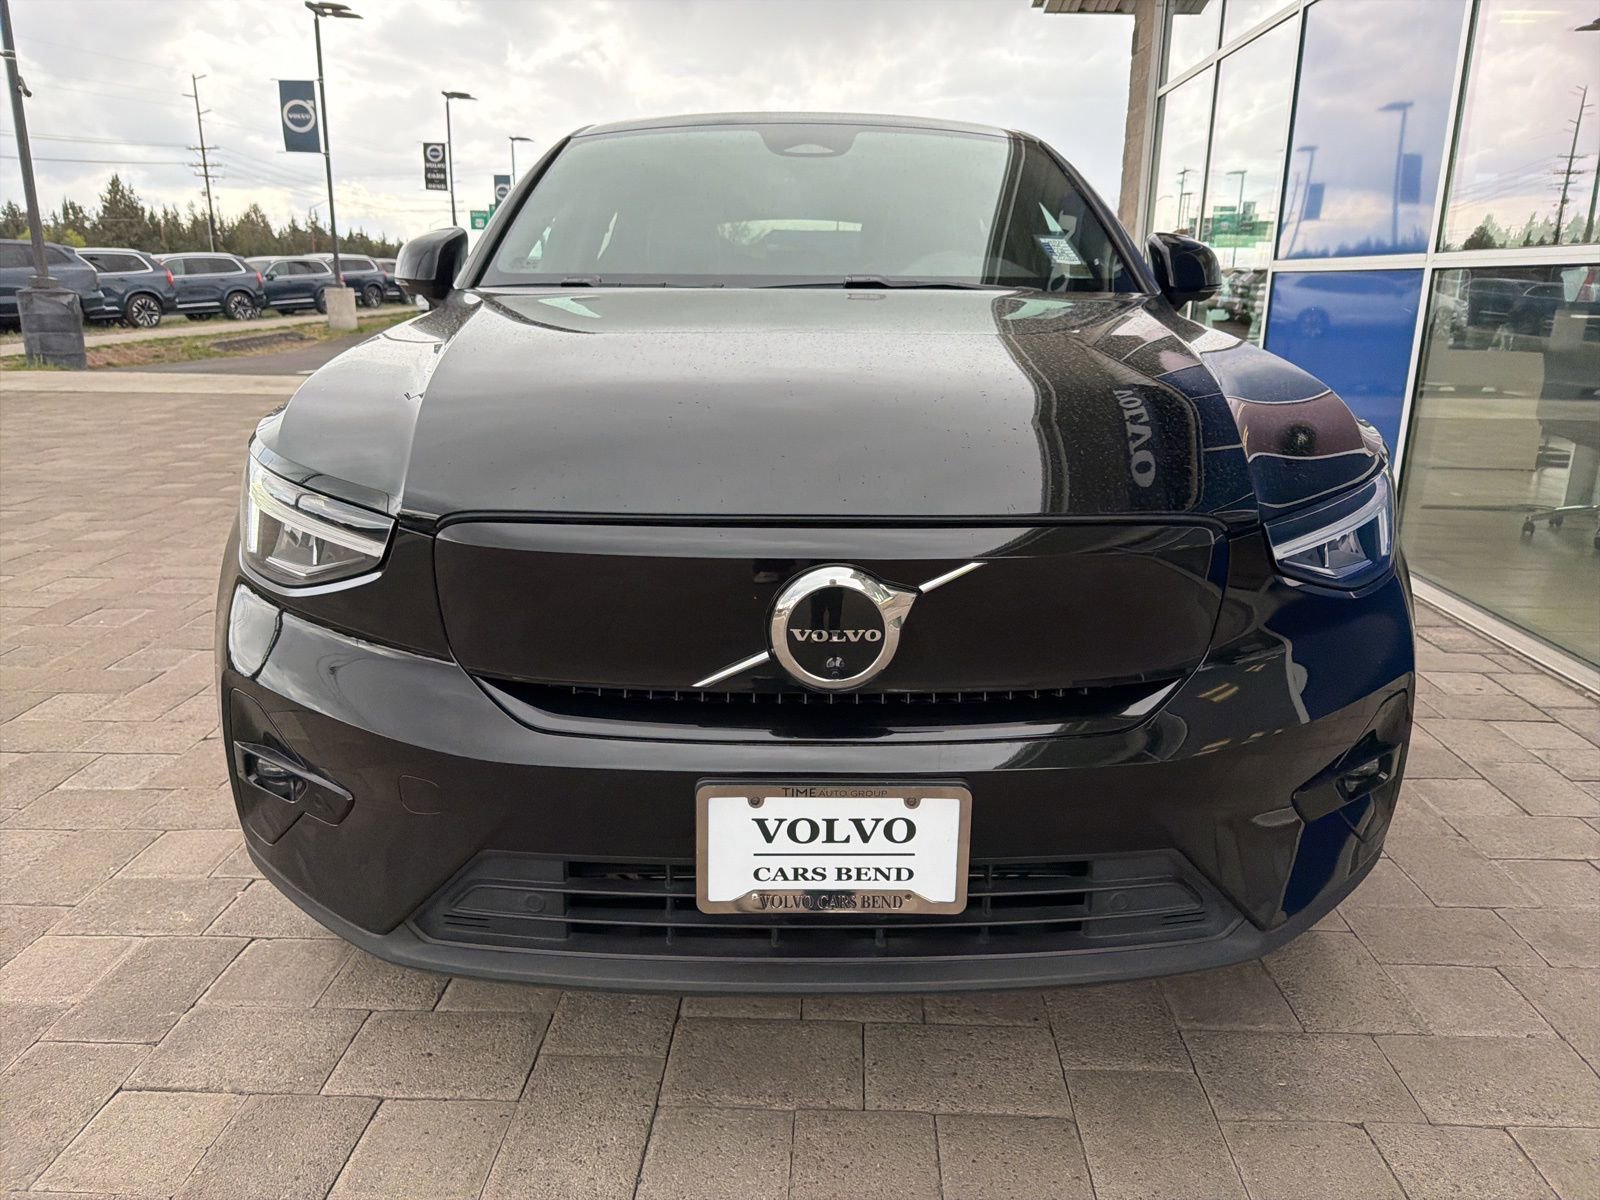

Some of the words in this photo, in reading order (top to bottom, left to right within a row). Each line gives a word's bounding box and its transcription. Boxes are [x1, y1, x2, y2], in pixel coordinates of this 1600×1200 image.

[790, 628, 882, 642] VOLVO
[781, 787, 816, 798] TIME
[819, 789, 848, 798] AUTO
[850, 789, 888, 798] GROUP
[752, 817, 917, 845] VOLVO
[753, 867, 827, 882] CARS
[834, 867, 915, 882] BEND
[759, 893, 814, 910] VOLVO
[817, 894, 857, 910] CARS
[860, 895, 904, 909] BEND
